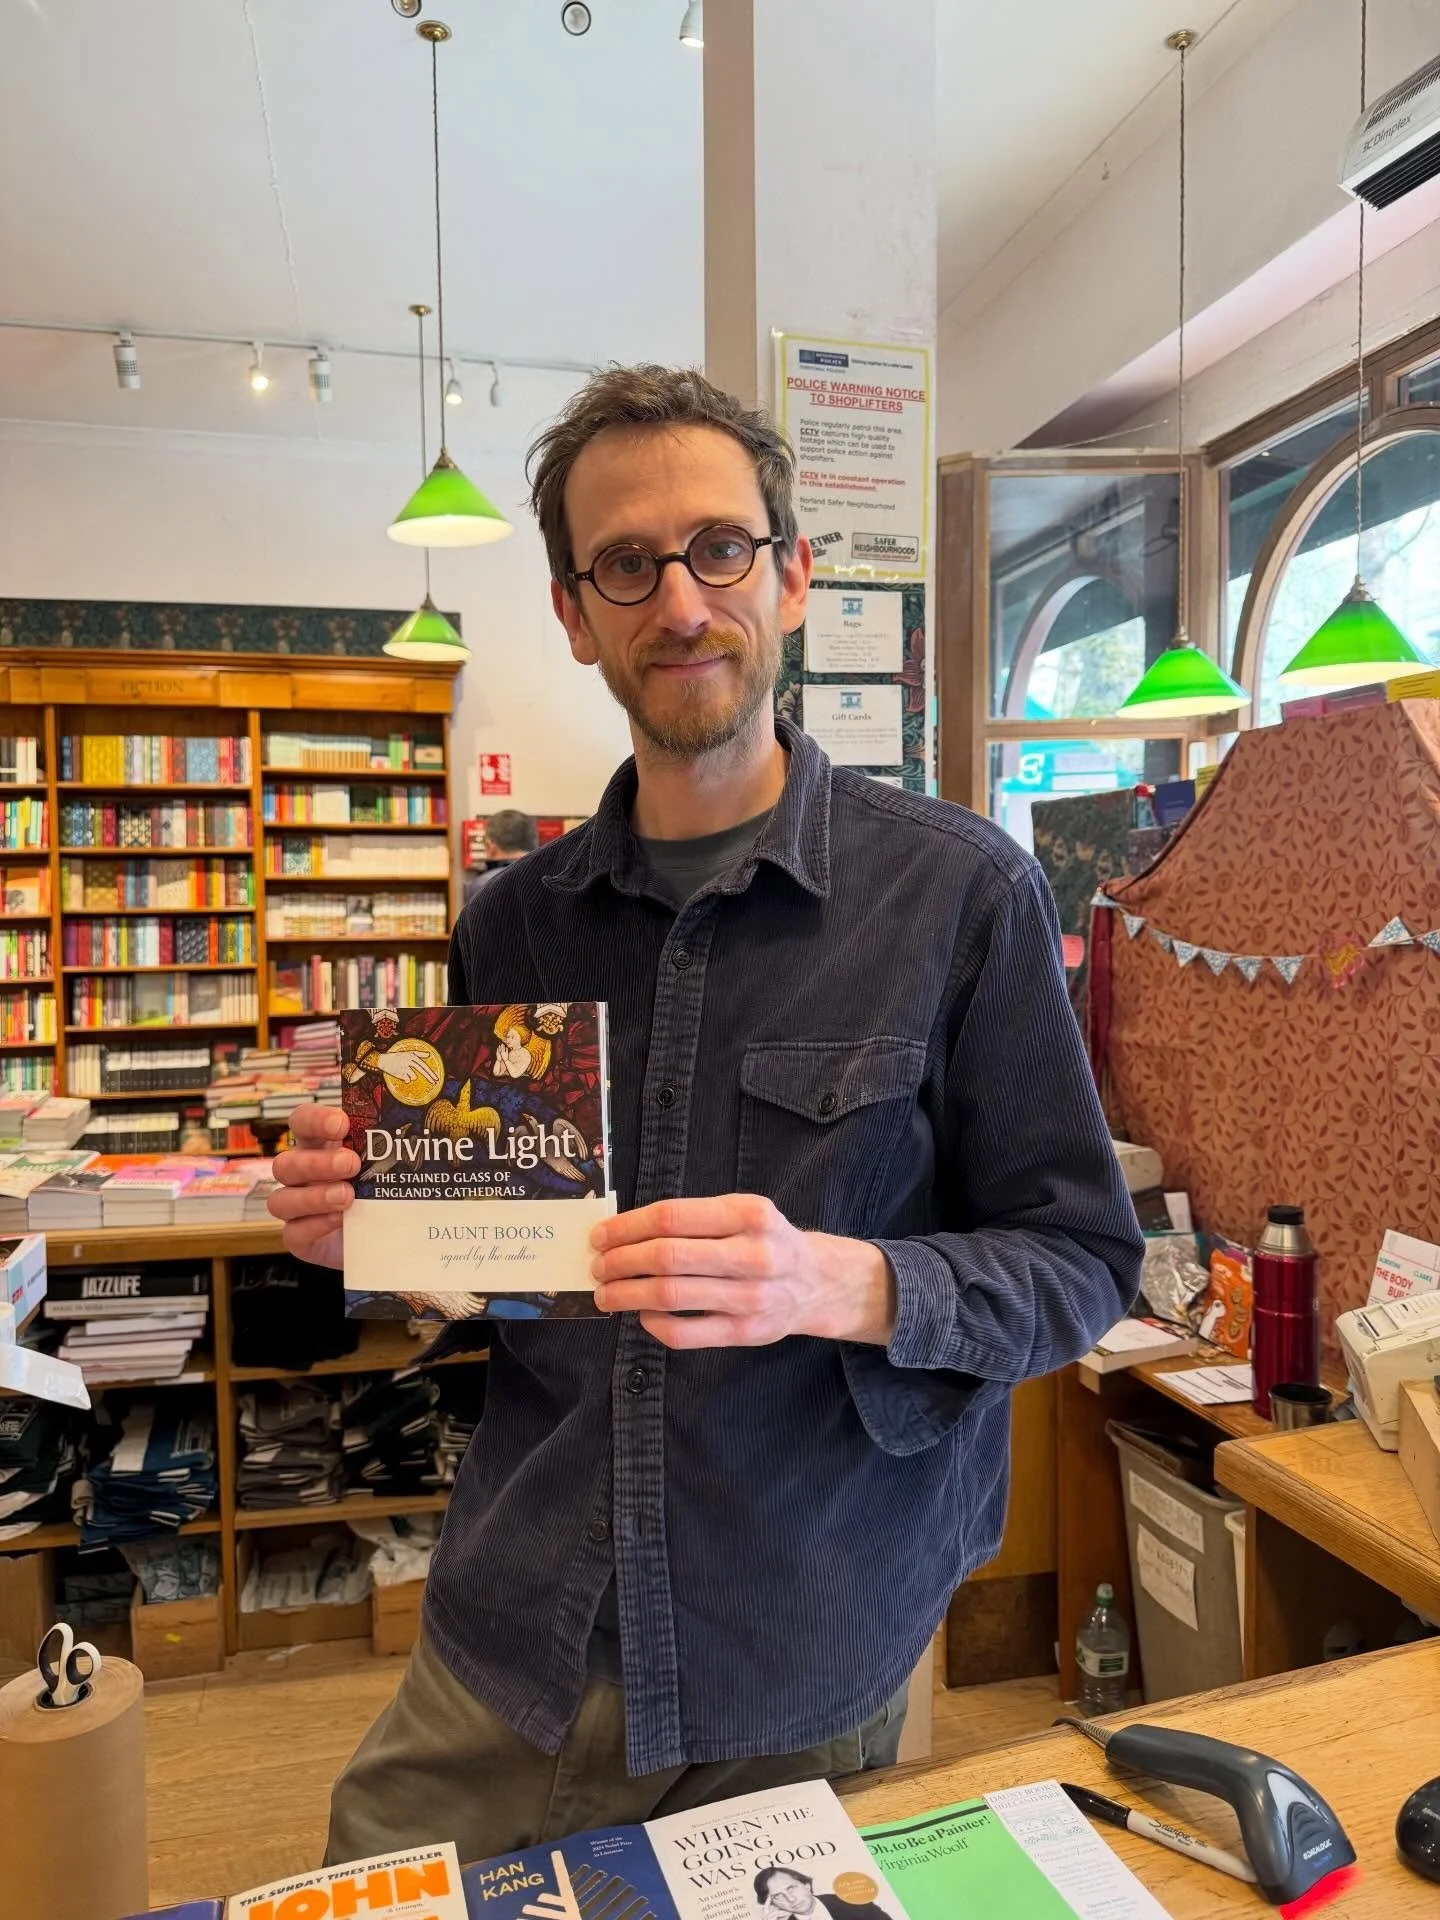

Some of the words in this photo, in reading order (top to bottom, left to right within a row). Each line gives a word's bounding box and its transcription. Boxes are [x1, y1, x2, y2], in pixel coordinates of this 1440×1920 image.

[787, 377, 828, 390] POLICE
[830, 382, 883, 396] WARNING
[886, 388, 926, 400] NOTICE
[810, 393, 826, 404] TO
[828, 395, 903, 411] SHOPLIFTERS
[800, 428, 819, 436] CCTV
[800, 471, 818, 479] CCTV
[809, 531, 844, 549] ETHER
[854, 544, 916, 555] NEIGHBOURHOODS
[874, 537, 897, 545] SAFER
[365, 1128, 474, 1162] Divine
[488, 1123, 577, 1169] Light
[374, 1172, 397, 1183] THE
[399, 1172, 450, 1183] STAINED
[453, 1171, 491, 1182] GLASS
[494, 1171, 511, 1182] OF
[375, 1187, 442, 1198] ENGLAND'S
[444, 1185, 526, 1197] CATHEDRALS
[428, 1226, 488, 1240] DAUNT
[494, 1226, 554, 1239] BOOKS
[439, 1245, 474, 1268] signed
[473, 1245, 490, 1268] by
[488, 1245, 504, 1261] the
[504, 1244, 536, 1261] author
[82, 1275, 141, 1298] JAZZLIFE
[1375, 1267, 1390, 1281] THE
[1389, 1273, 1414, 1290] BODY
[673, 1816, 763, 1852] WHEN
[766, 1807, 815, 1826] THE
[892, 1837, 907, 1851] to
[908, 1833, 929, 1848] Be
[928, 1832, 937, 1842] a
[935, 1815, 991, 1841] Painter!
[682, 1833, 774, 1871] GOING
[927, 1837, 969, 1860] Woolf
[480, 1861, 524, 1885] HAN
[688, 1861, 747, 1889] WAS
[754, 1840, 837, 1869] GOOD
[240, 1893, 265, 1907] THE
[268, 1877, 324, 1898] SUNDAY
[327, 1867, 365, 1881] TIMES
[367, 1851, 443, 1871] BESTSELLER
[481, 1873, 545, 1901] KANG
[733, 1903, 749, 1911] the
